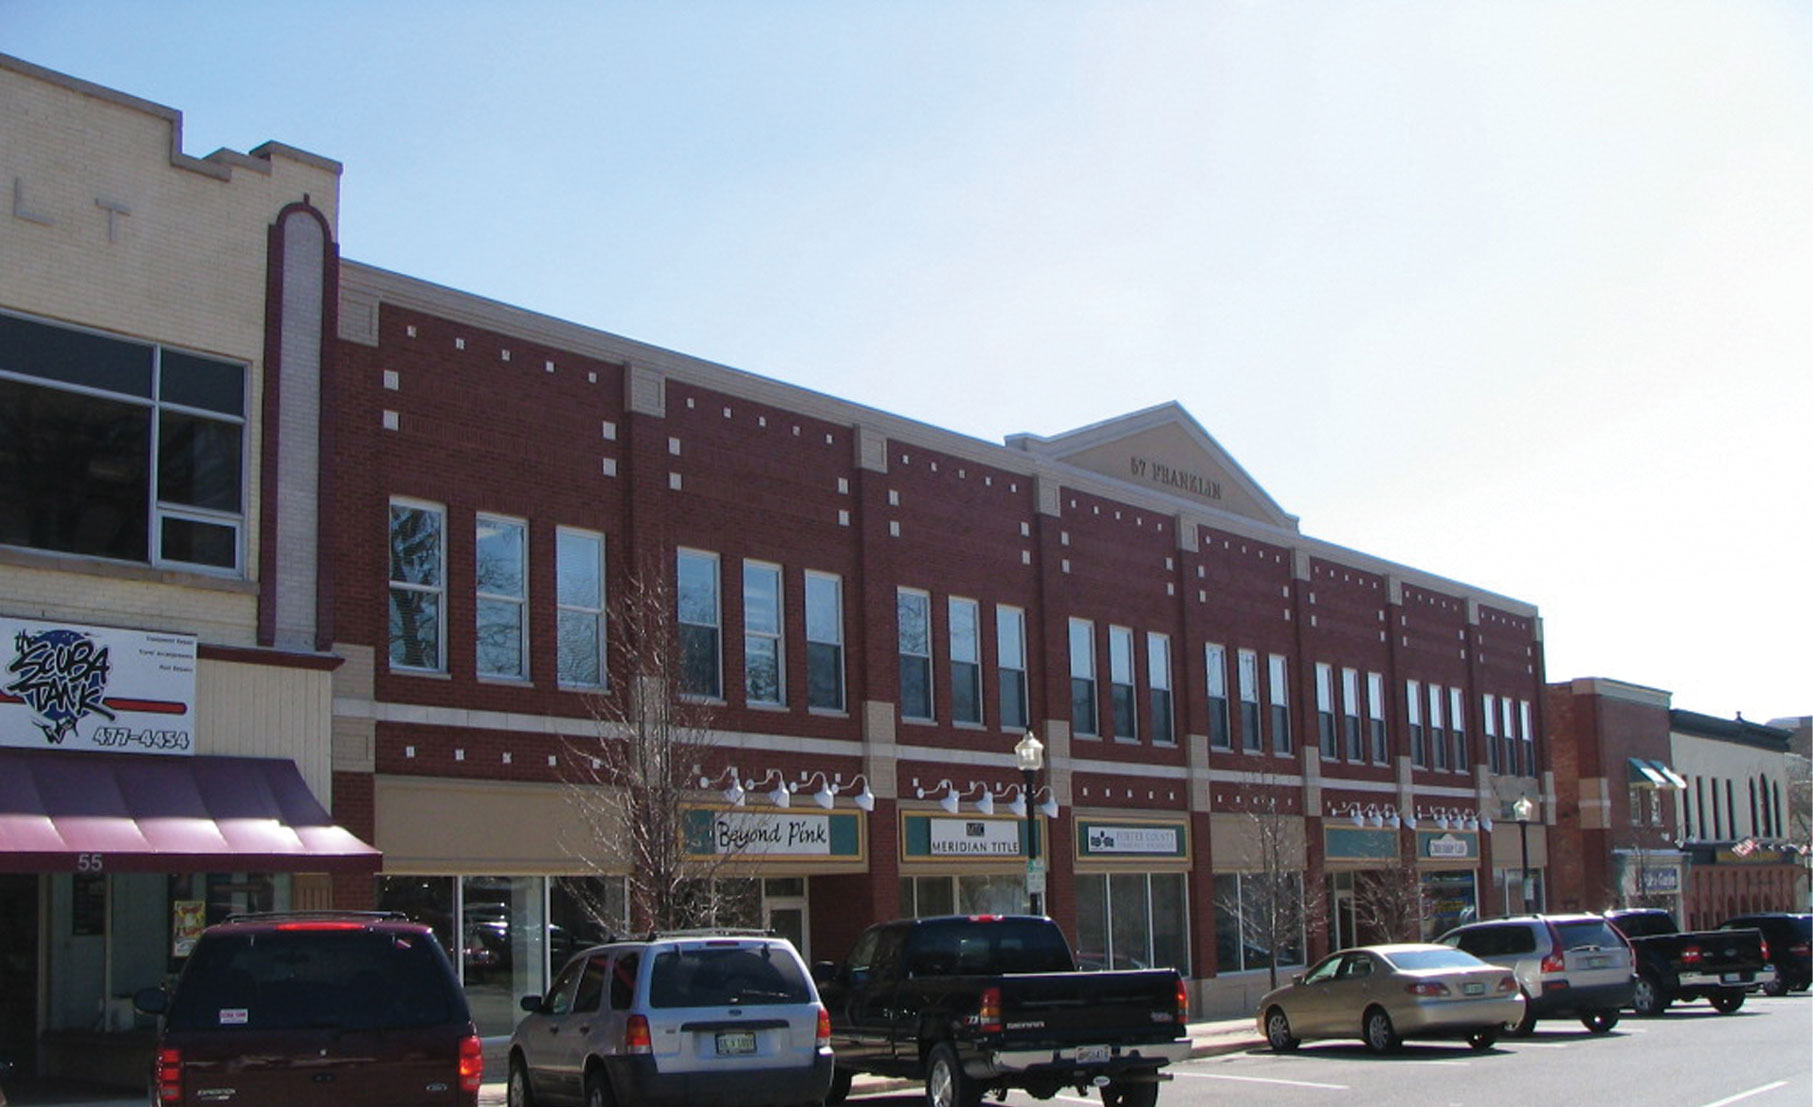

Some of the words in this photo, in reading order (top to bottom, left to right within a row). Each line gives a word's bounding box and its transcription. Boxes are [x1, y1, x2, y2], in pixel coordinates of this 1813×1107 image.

[1152, 462, 1221, 500] FRANKLIN
[7, 640, 110, 692] SCUBA
[19, 677, 115, 721] TANK
[93, 727, 190, 749] 477-4454
[717, 821, 782, 849] Beyond
[788, 820, 827, 846] Pink
[932, 841, 987, 852] MERIDIAN
[992, 842, 1018, 852] TITLE
[78, 854, 103, 871] 55
